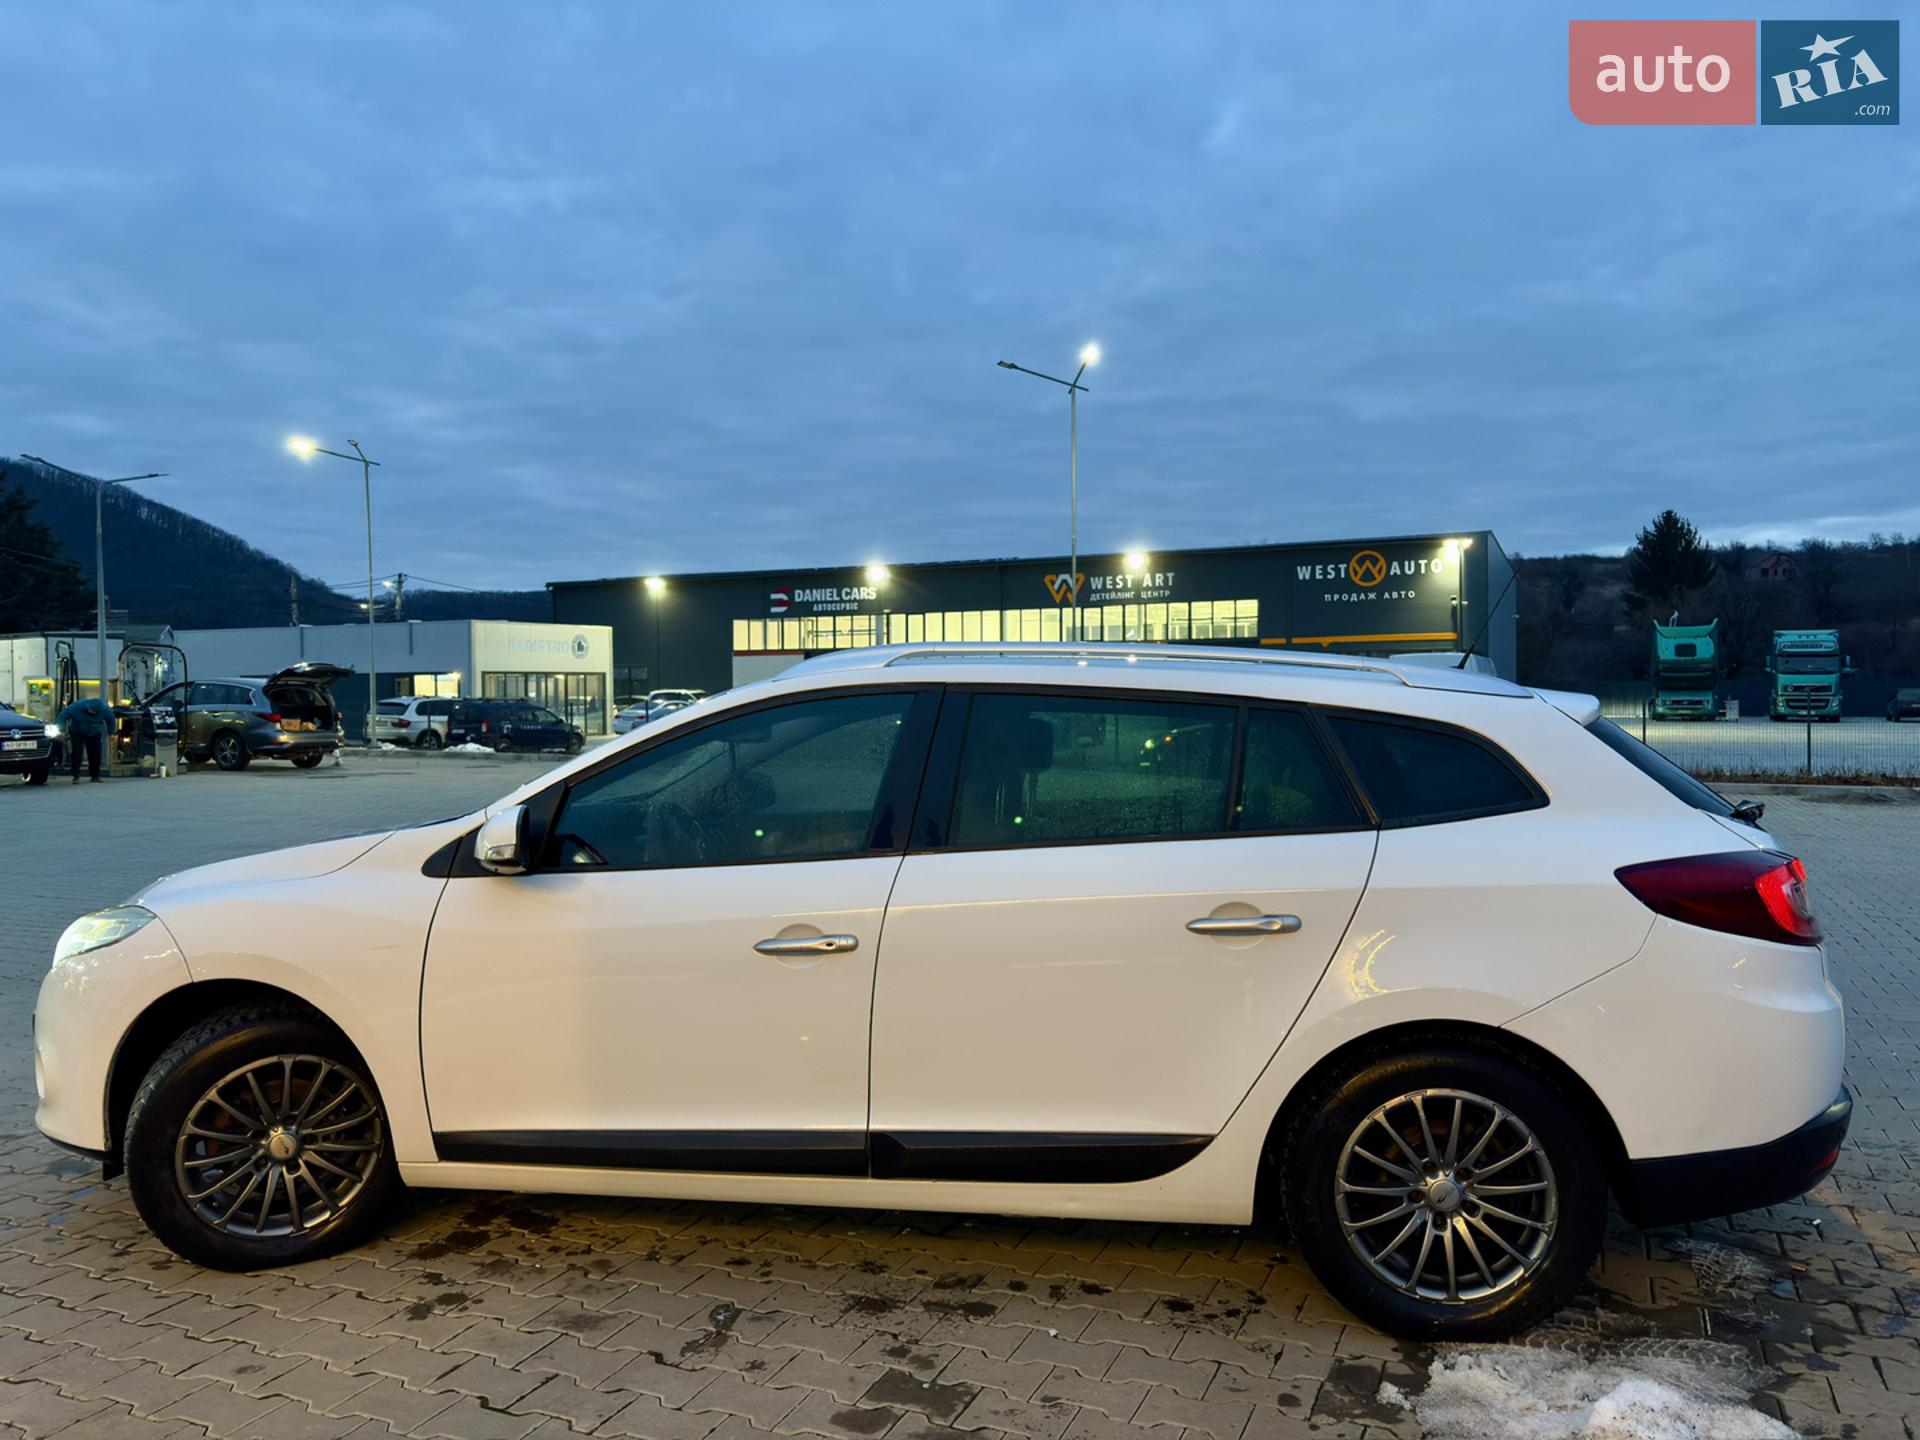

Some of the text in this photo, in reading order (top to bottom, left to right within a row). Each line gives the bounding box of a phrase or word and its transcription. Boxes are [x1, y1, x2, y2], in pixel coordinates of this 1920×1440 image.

[1297, 558, 1443, 580] WEST AUTO
[1090, 572, 1176, 589] WEST ART
[794, 586, 877, 602] DANIEL CARS
[1090, 590, 1171, 602] ДЕТЕЙЛІНГ ЦЕНТР
[1324, 590, 1416, 602] ПРОДАЖ АВТО
[813, 602, 859, 611] АВТОСЕРВІС
